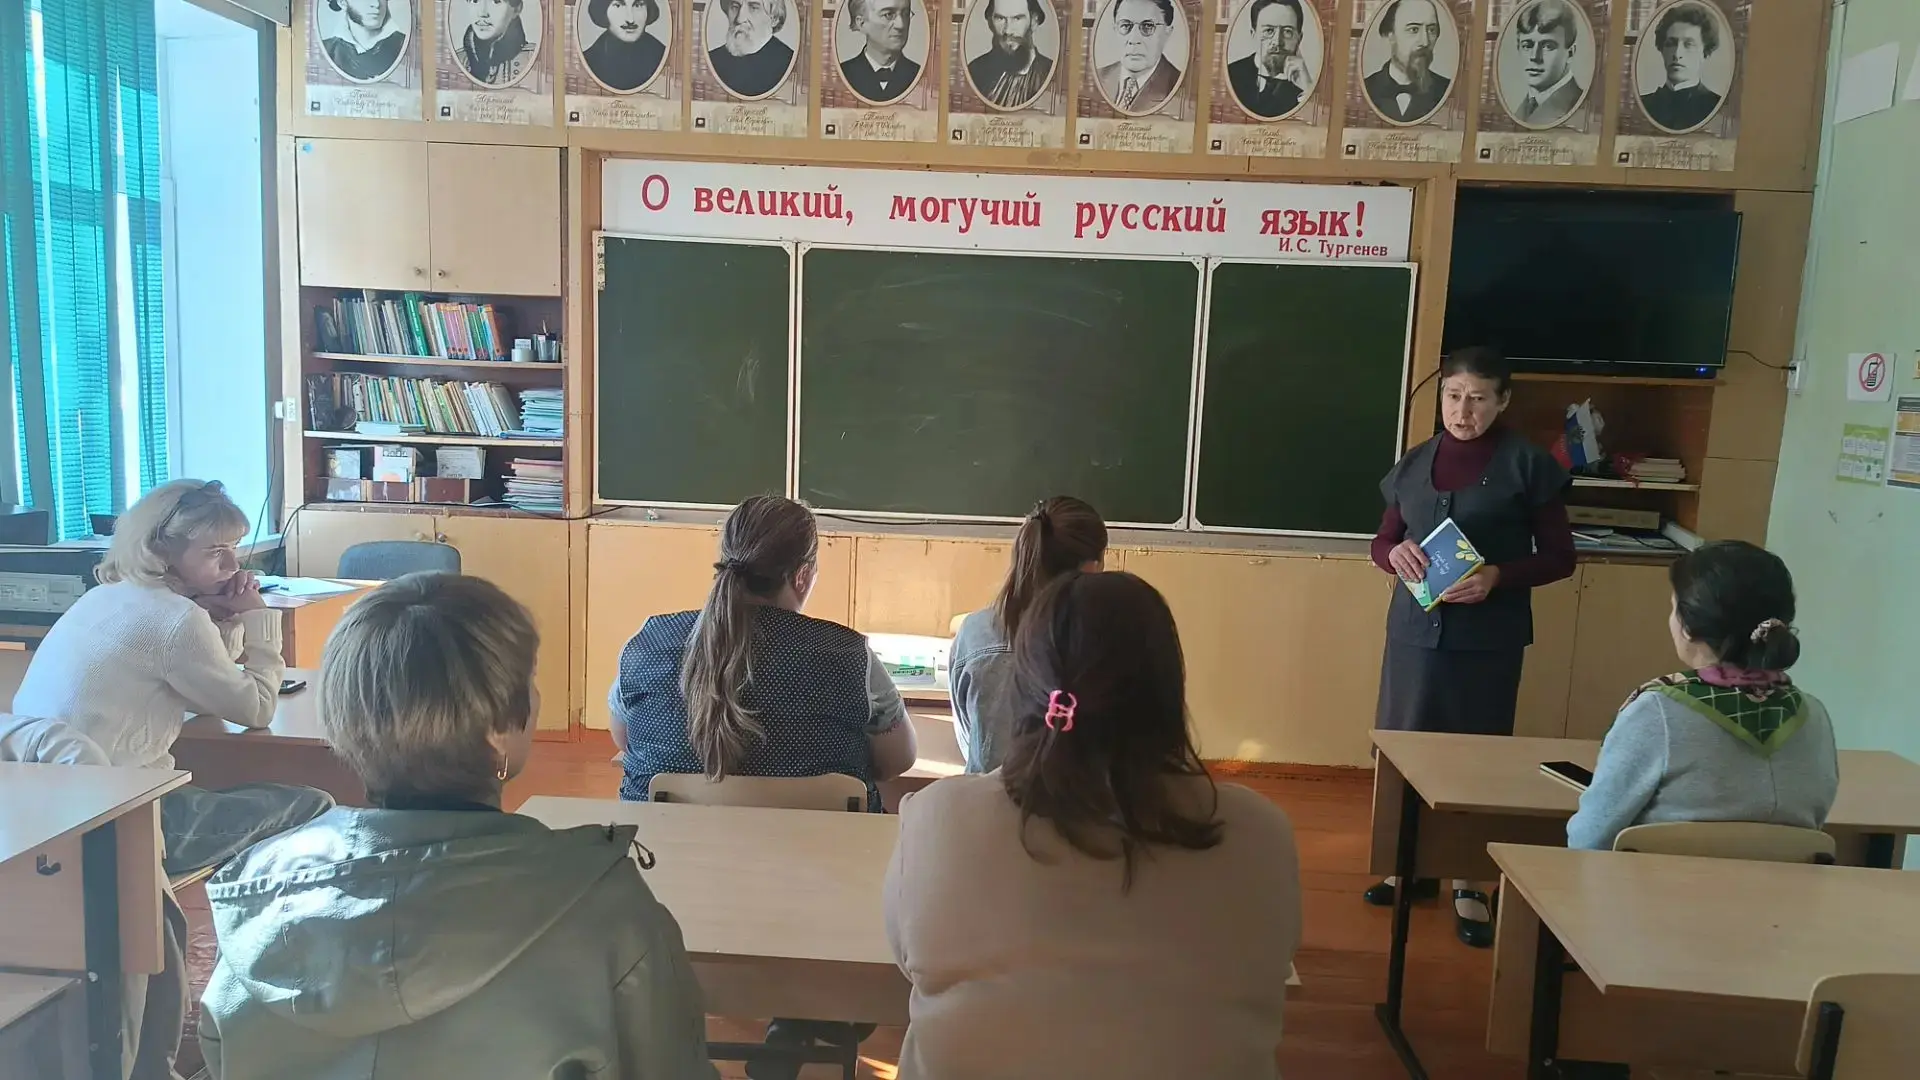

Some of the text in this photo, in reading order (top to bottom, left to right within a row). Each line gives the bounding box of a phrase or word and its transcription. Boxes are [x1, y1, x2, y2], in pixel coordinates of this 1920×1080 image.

[641, 174, 1365, 239] О великий, могучий русский язык!
[1318, 239, 1388, 259] Тургенев
